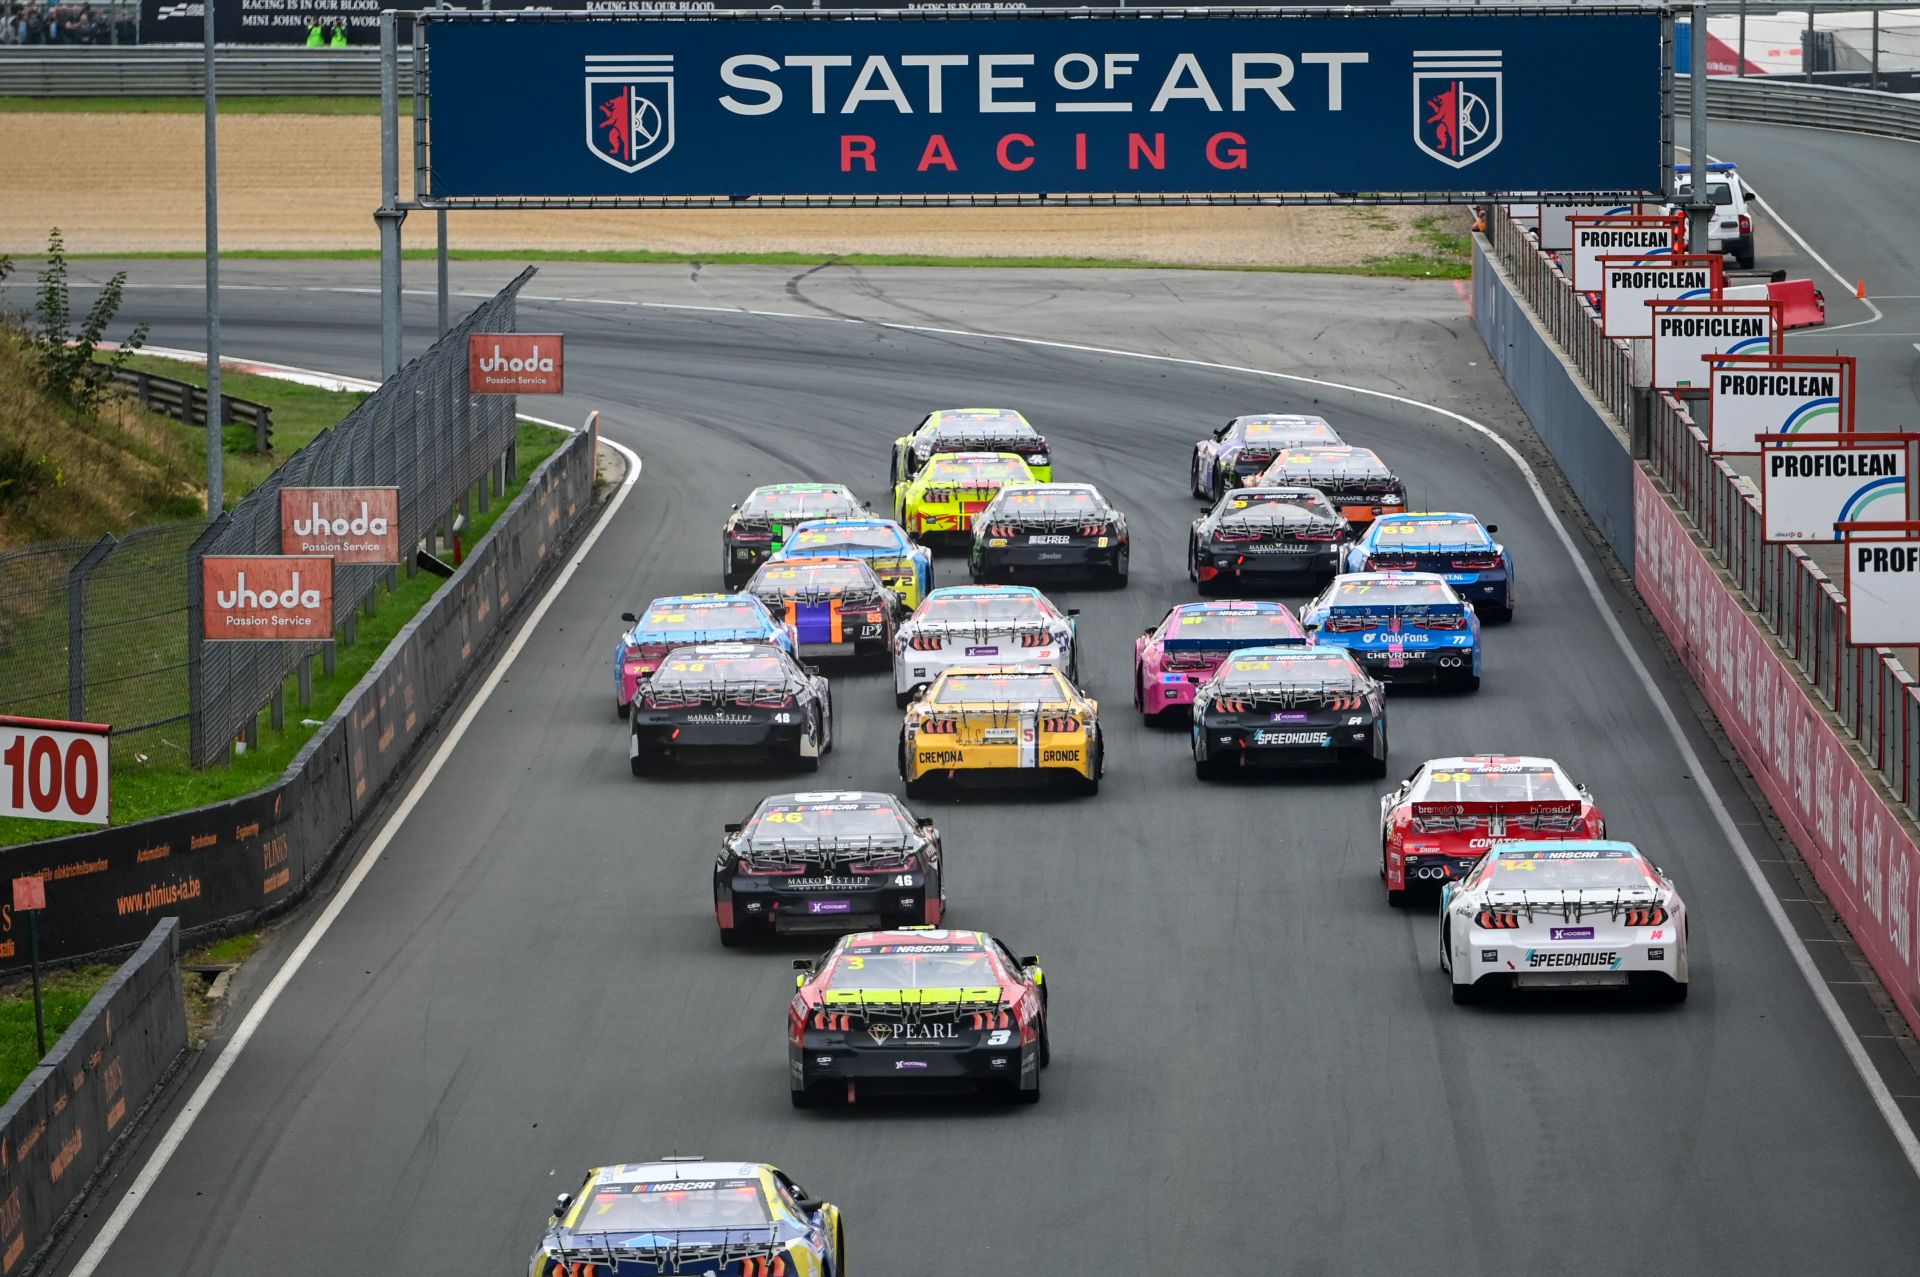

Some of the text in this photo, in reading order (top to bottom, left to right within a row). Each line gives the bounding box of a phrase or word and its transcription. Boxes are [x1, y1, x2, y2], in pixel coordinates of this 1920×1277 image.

[242, 0, 284, 10] RACING
[287, 0, 297, 10] IS
[299, 0, 313, 10] IN
[316, 0, 339, 10] OUR
[242, 15, 269, 26] MINI
[271, 15, 301, 26] JOHN
[719, 52, 1368, 116] STATE OF ART
[840, 131, 1249, 172] RACING
[1581, 231, 1668, 247] PROFICLEAN
[1611, 272, 1706, 289] PROFICLEAN
[1660, 318, 1763, 337] PROFICLEAN
[480, 345, 553, 372] uhoda
[486, 376, 547, 385] Passion Service
[1720, 375, 1833, 397] PROFICLEAN
[1771, 453, 1896, 478] PROFICLEAN
[293, 501, 388, 536] uhoda
[302, 542, 380, 551] Passion Service
[1858, 547, 1920, 573] PROF
[216, 571, 320, 609] uhoda
[226, 615, 312, 626] Passion Service
[867, 612, 883, 624] 55
[1380, 632, 1429, 645] OnlyFans
[1452, 635, 1466, 645] 77
[774, 712, 790, 723] 48
[1348, 716, 1363, 726] 64
[1257, 732, 1328, 745] SPEEDHOUSE
[919, 750, 963, 763] CREMONA
[1043, 750, 1080, 762] GRONDE
[4, 735, 98, 816] 100
[811, 804, 859, 812] NASCAR
[766, 812, 803, 823] 46
[1549, 851, 1599, 859] NASCAR
[788, 876, 871, 885] MARKO STIPP
[895, 875, 913, 887] 46
[117, 874, 200, 916] www.plinius-ia.be
[1651, 930, 1664, 940] 14
[896, 945, 950, 953] NASCAR
[847, 956, 865, 970] 3
[1529, 952, 1617, 967] SPEEDHOUSE
[892, 1022, 959, 1039] PEARL
[987, 1029, 1012, 1046] 3
[653, 1181, 716, 1192] NASCAR
